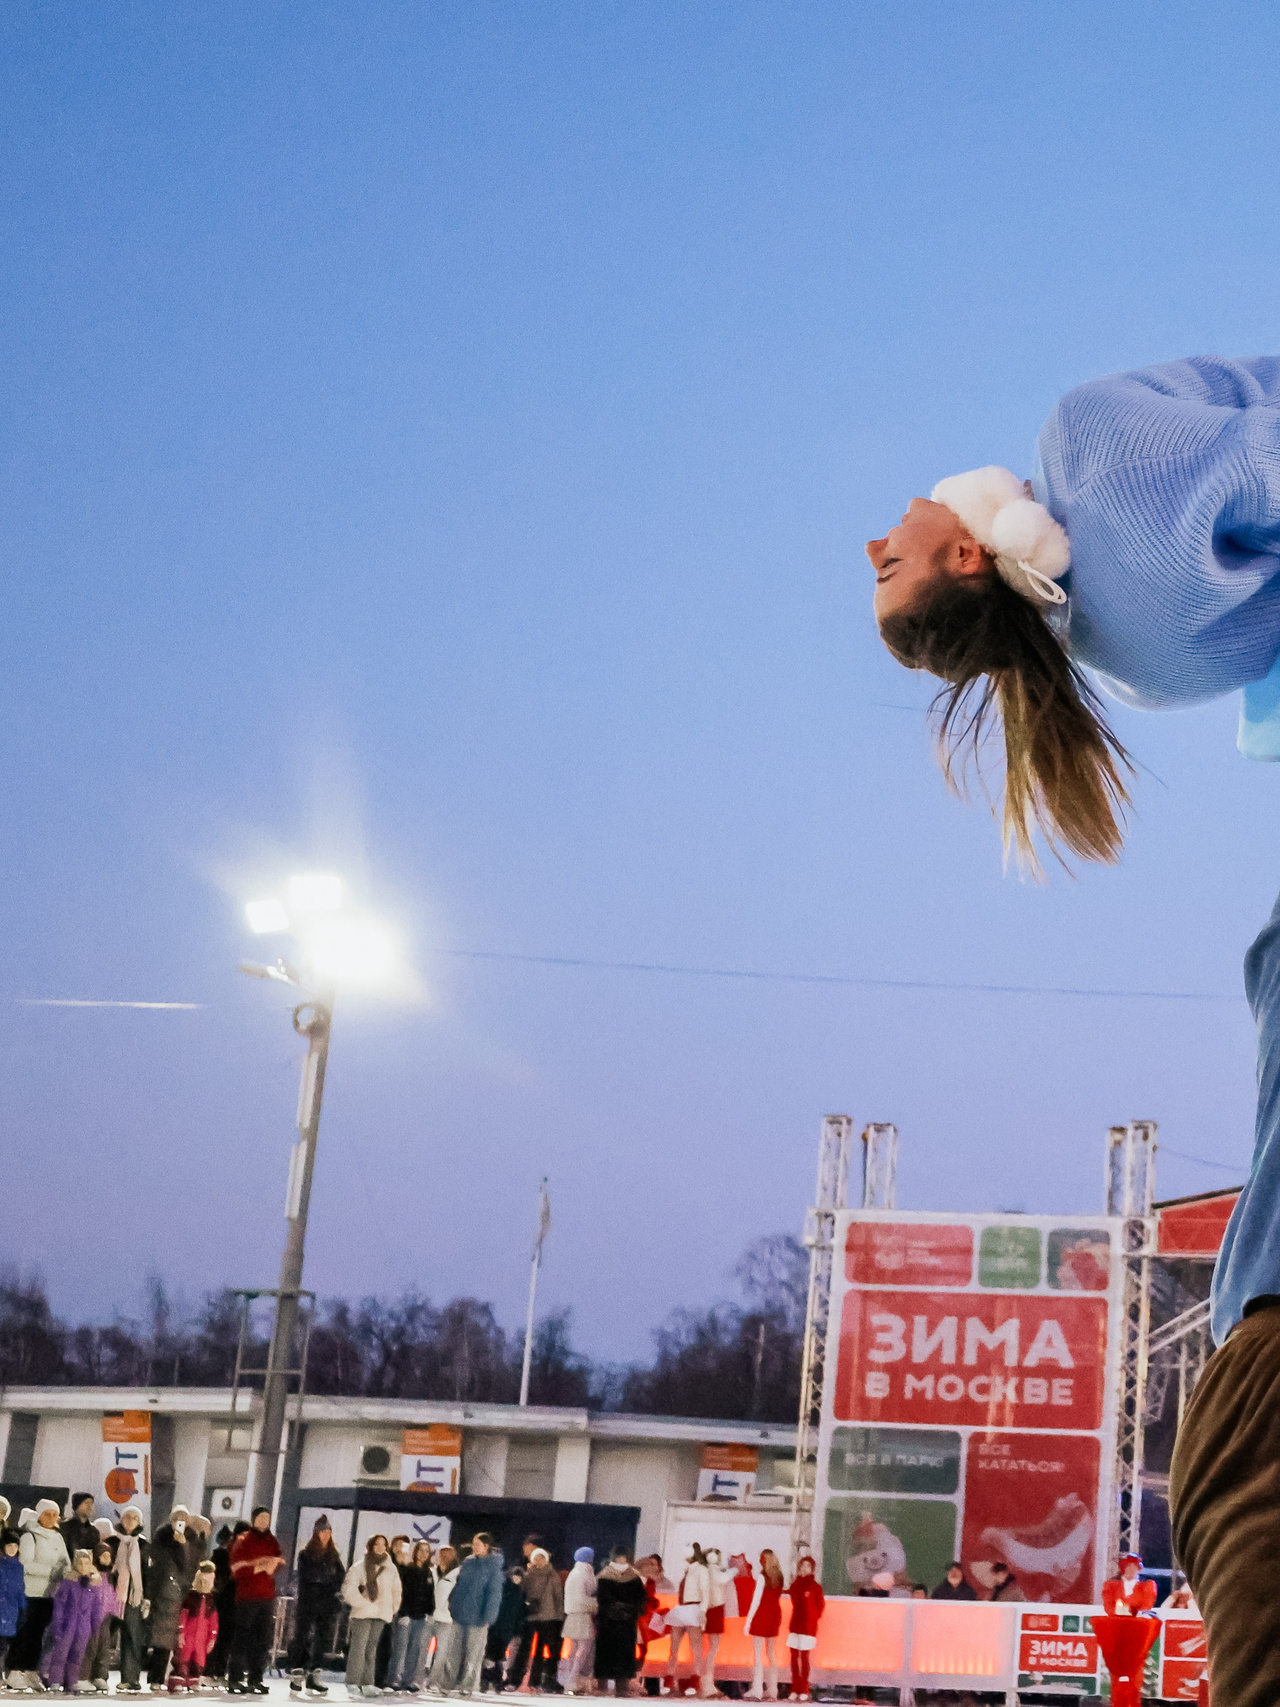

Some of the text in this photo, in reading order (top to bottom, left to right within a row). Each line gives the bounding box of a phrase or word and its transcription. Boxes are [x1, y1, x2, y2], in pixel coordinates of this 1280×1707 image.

[868, 1313, 1075, 1368] ЗИМА
[865, 1371, 1075, 1406] В МОСКВЕ
[1029, 1640, 1088, 1657] ЗИМА
[1040, 1657, 1088, 1668] МОСКВЕ
